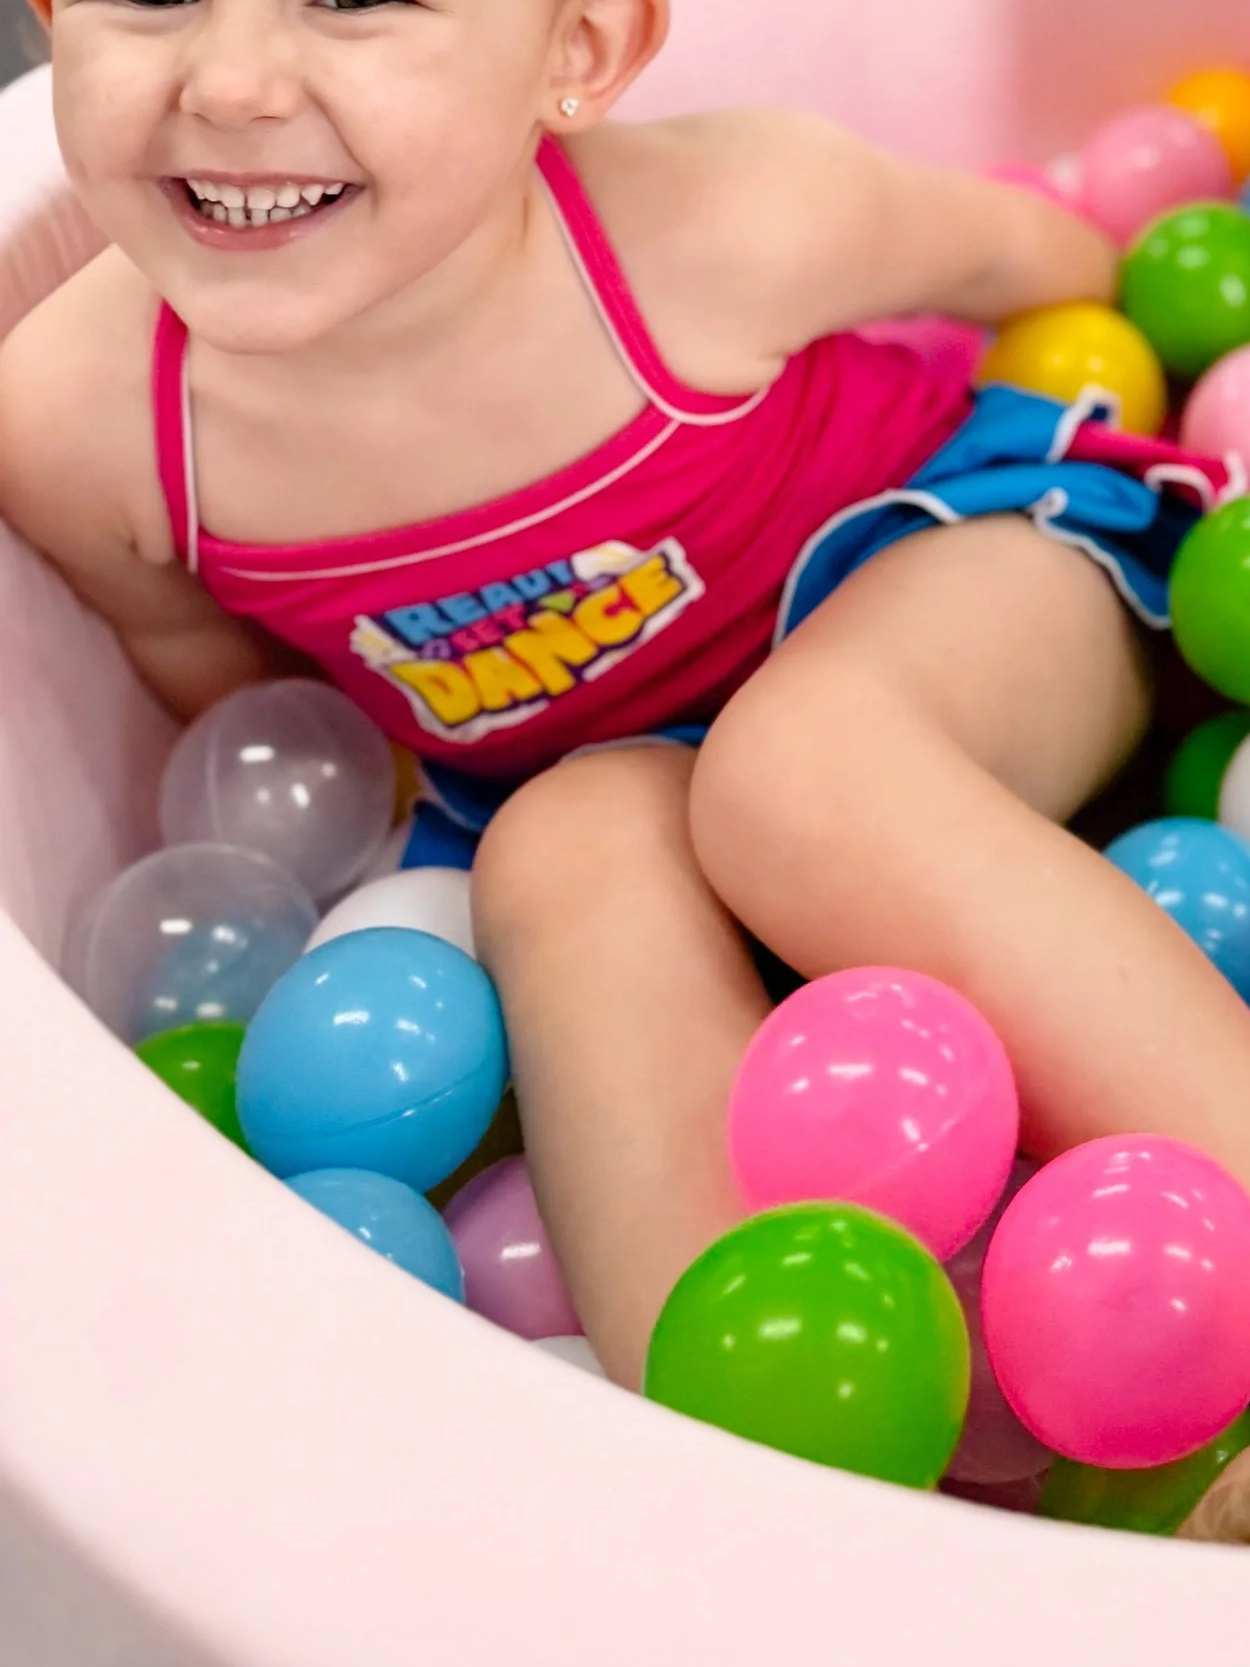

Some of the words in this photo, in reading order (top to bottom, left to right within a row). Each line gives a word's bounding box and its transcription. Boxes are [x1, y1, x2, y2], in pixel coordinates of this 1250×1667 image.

[385, 560, 574, 646] READY
[390, 554, 683, 725] DANCE
[452, 603, 526, 652] SET
